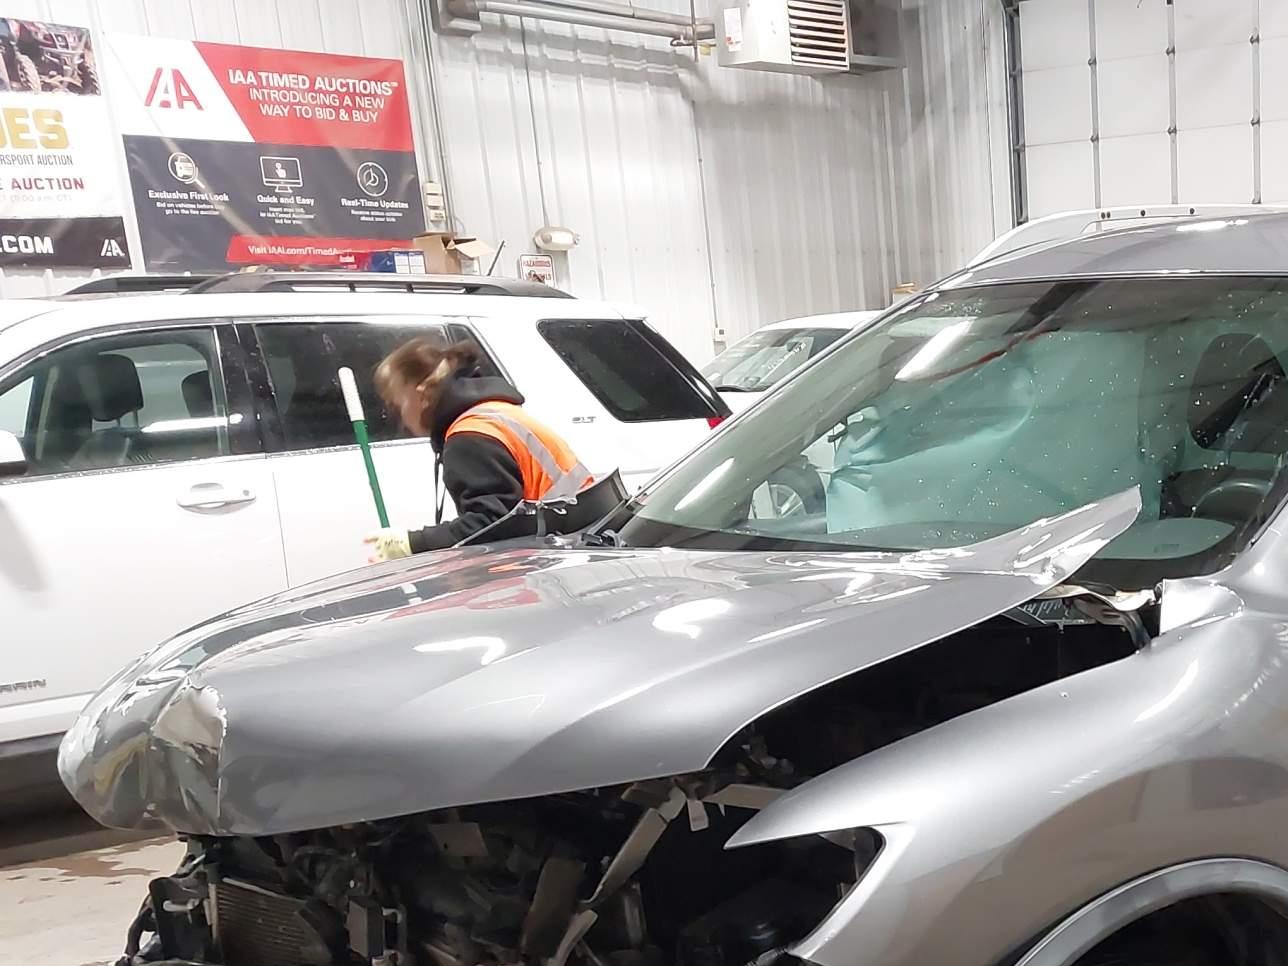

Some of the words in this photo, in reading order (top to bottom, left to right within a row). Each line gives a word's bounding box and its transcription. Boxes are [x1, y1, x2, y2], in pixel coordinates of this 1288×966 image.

[228, 69, 257, 86] IAA
[257, 72, 310, 89] TIMED
[249, 88, 340, 106] INTRODUCING
[342, 95, 353, 107] A
[355, 96, 385, 109] NEW
[259, 103, 291, 117] WAY
[293, 105, 313, 119] TO
[315, 107, 336, 120] BID
[339, 108, 350, 121] &
[352, 110, 379, 123] BUY
[0, 108, 70, 149] ES
[37, 154, 74, 166] AUCTION
[11, 177, 85, 191] AUCTION
[148, 189, 189, 200] Exclusive
[190, 191, 208, 201] First
[256, 194, 278, 204] Quick
[280, 196, 294, 204] and
[295, 196, 315, 206] Easy
[341, 198, 379, 208] Real-Time
[380, 200, 409, 209] Updates
[248, 245, 266, 255] Visit
